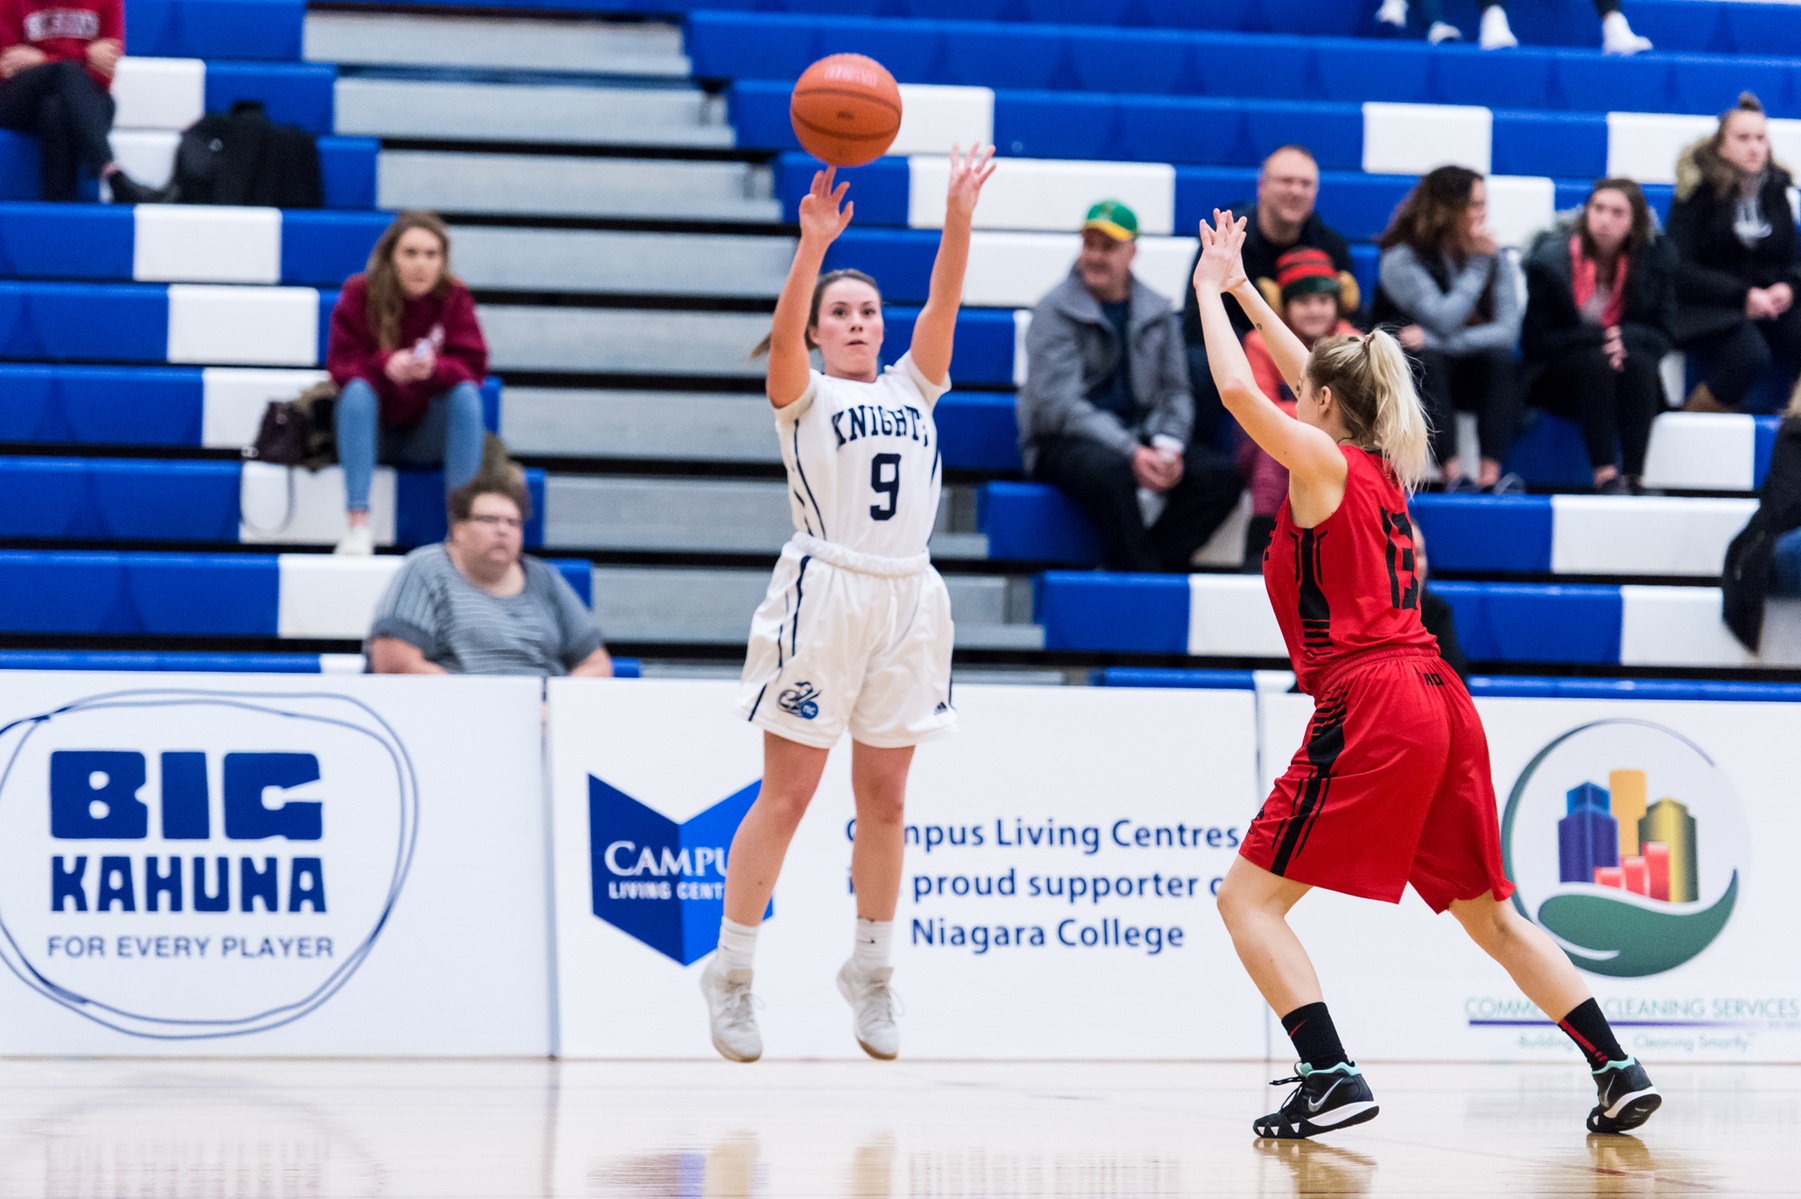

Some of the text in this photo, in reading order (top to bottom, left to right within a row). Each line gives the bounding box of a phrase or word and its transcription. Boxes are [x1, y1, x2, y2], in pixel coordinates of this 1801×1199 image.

[870, 453, 901, 521] 9
[49, 750, 324, 841] BIG
[846, 818, 1240, 855] Cmpus Living Centres
[604, 840, 727, 877] CAMPU
[50, 855, 328, 914] KAHUNA
[608, 881, 725, 900] LIVING CENT
[913, 867, 1016, 904] proud
[1028, 873, 1199, 904] supporter
[47, 935, 334, 960] FOR EVERY PLAYER
[911, 918, 1184, 956] Niagara College
[1603, 998, 1706, 1017] CLEANING
[1712, 998, 1800, 1017] SERVICES
